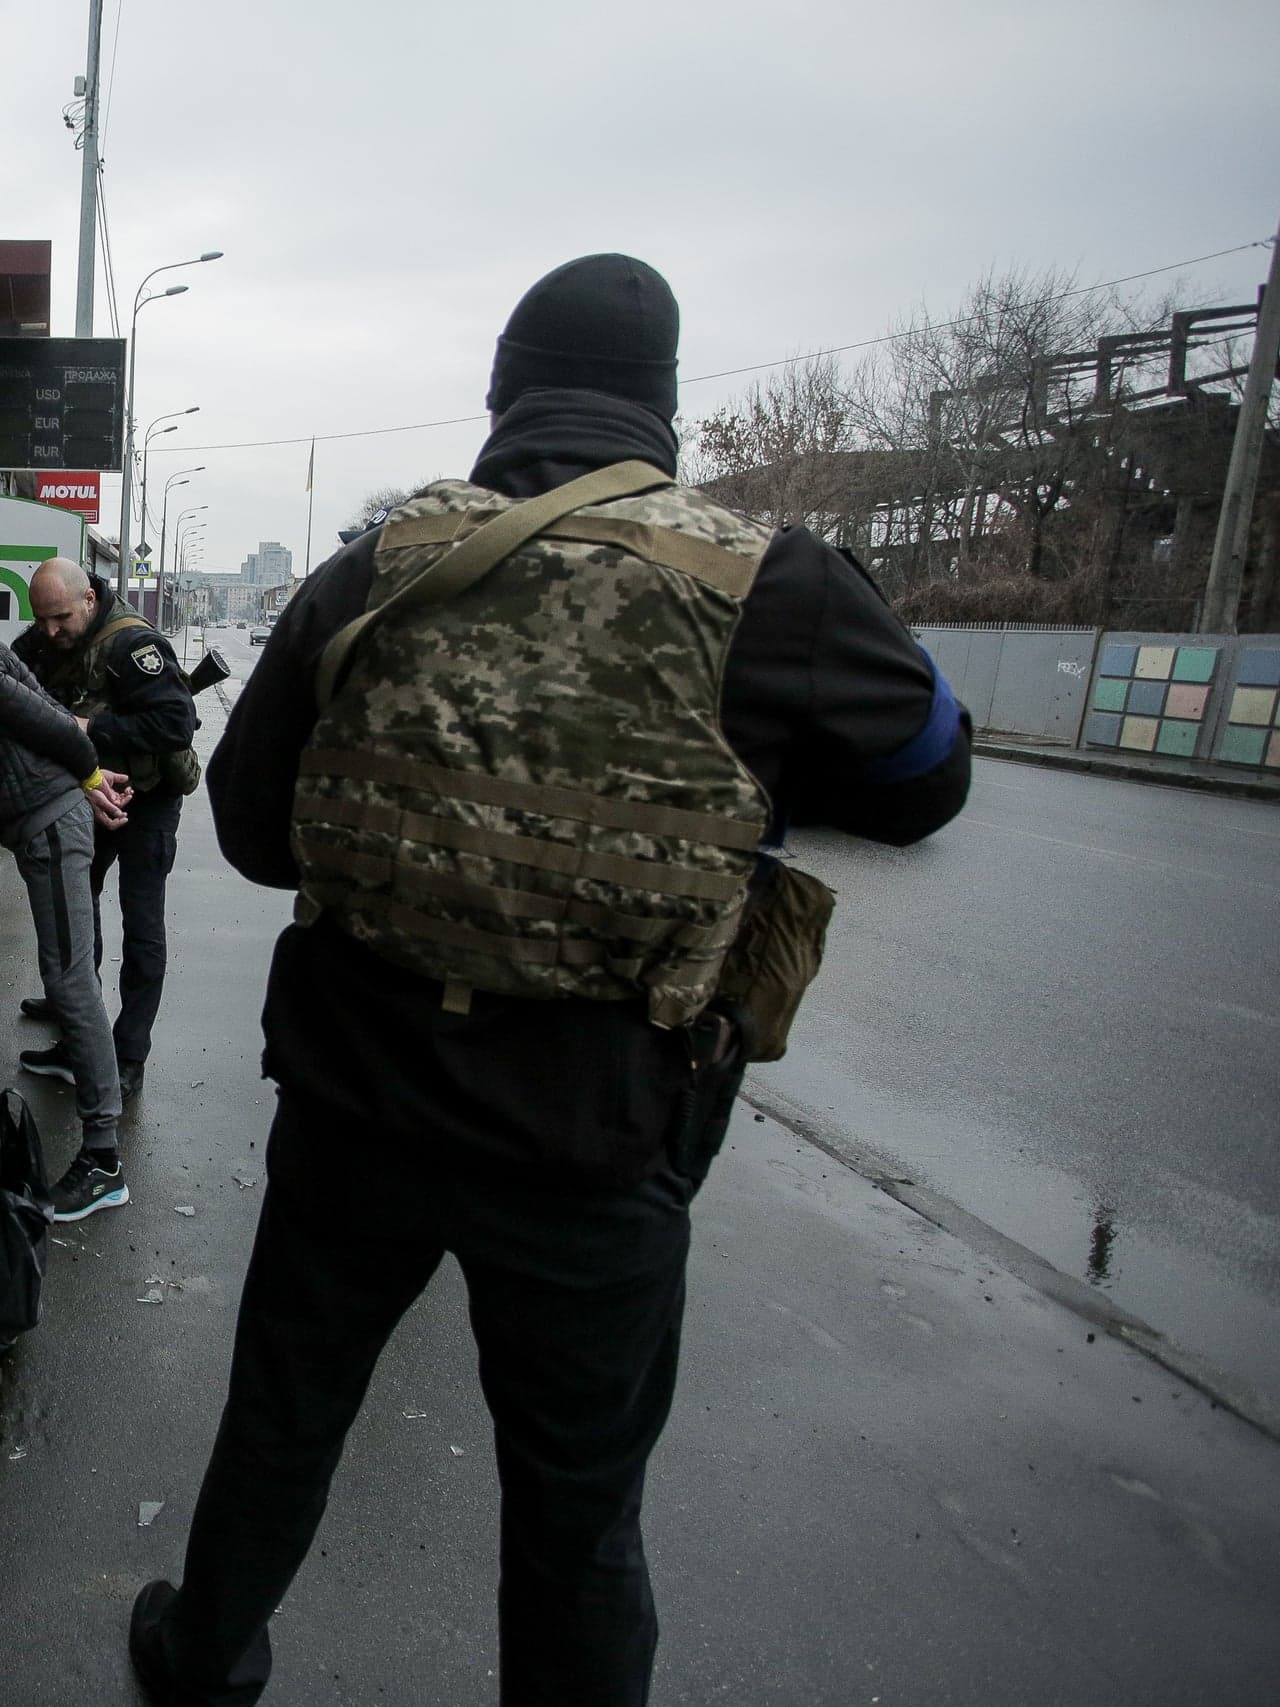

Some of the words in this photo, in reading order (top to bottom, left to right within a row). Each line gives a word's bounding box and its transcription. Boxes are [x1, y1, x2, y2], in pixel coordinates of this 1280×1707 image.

[64, 370, 117, 381] ПРОДАЖА
[35, 388, 61, 400] USD
[35, 417, 60, 429] EUR
[34, 445, 59, 457] RUR
[40, 485, 97, 498] MOTUL
